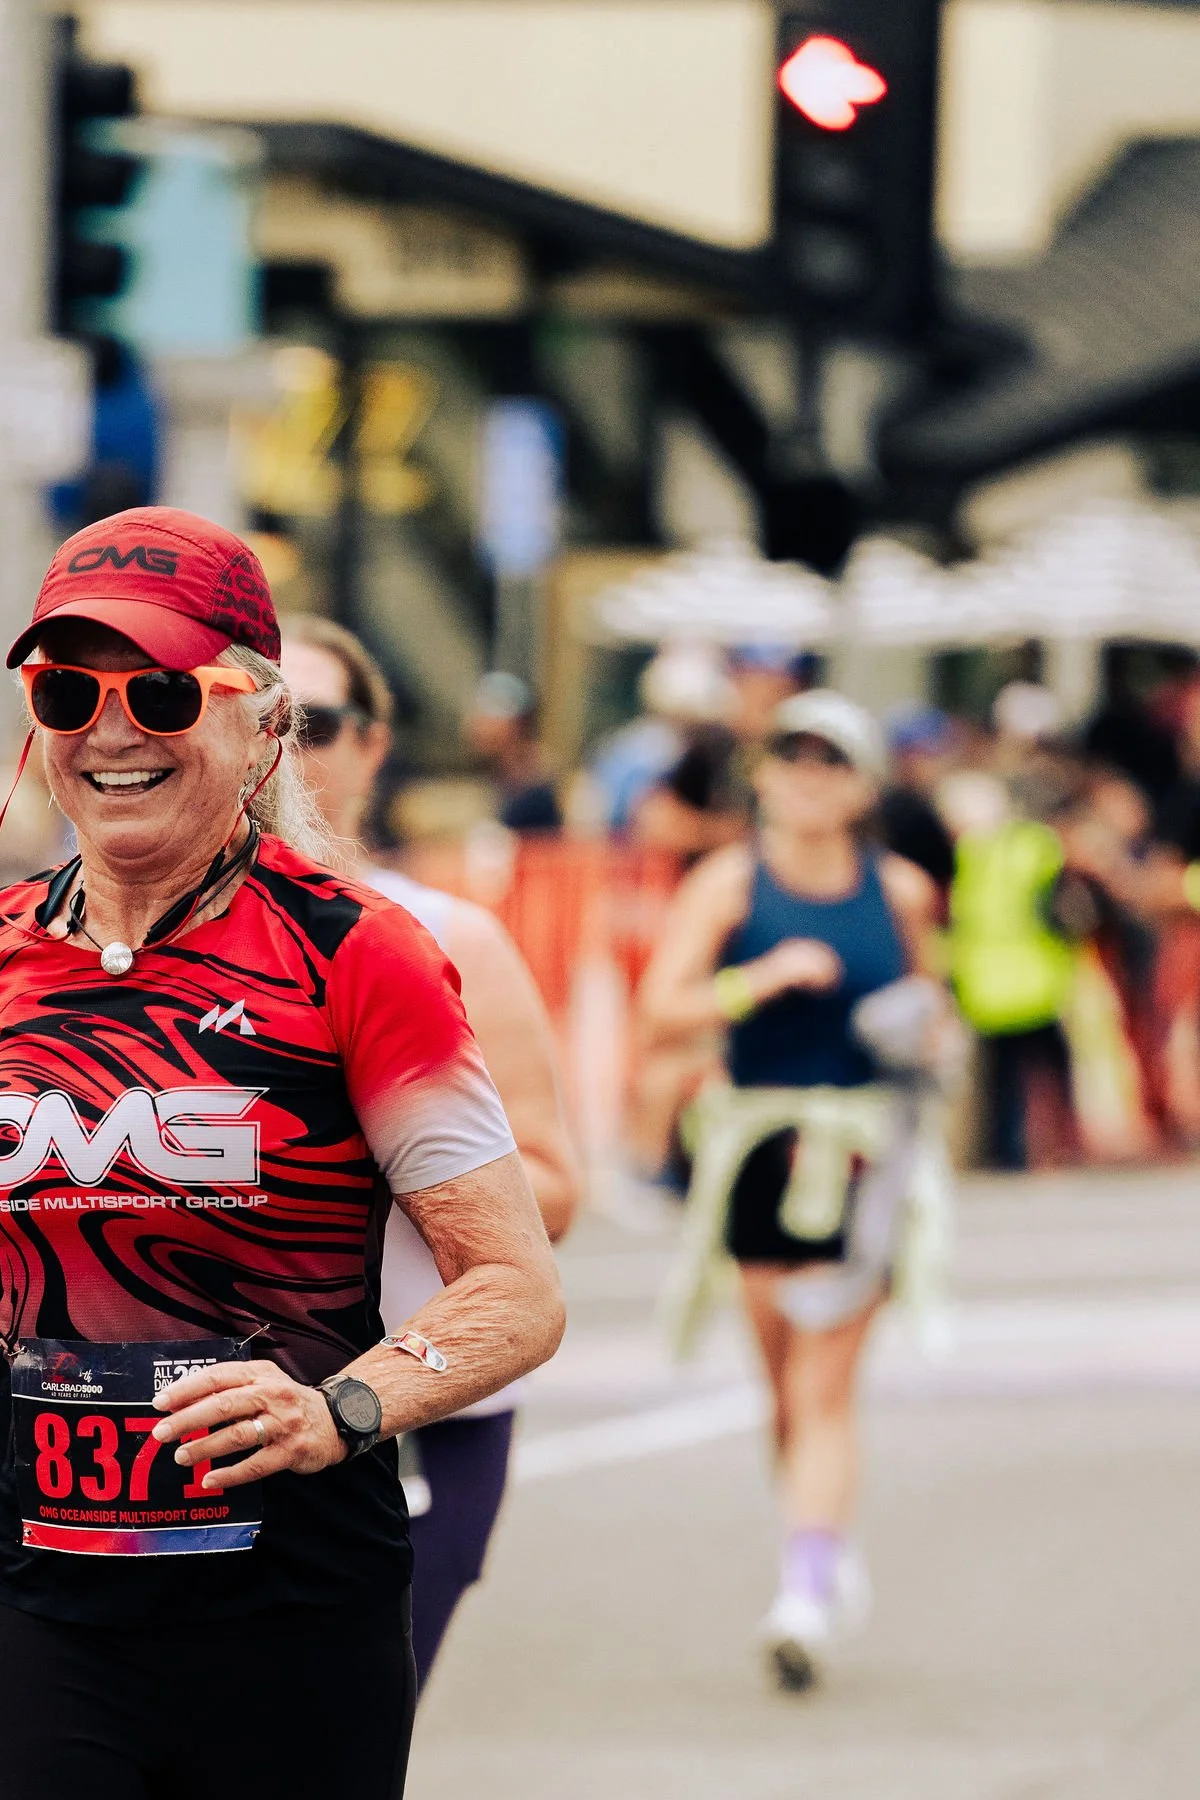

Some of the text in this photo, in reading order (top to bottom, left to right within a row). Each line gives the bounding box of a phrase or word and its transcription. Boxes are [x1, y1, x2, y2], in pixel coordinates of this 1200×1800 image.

[68, 545, 178, 576] OMG
[44, 1195, 181, 1210] MULTISPORT
[185, 1194, 268, 1209] GROUP
[153, 1366, 174, 1379] ALL
[41, 1381, 104, 1394] CARLSBAD5000
[39, 1505, 230, 1523] OMG OCEANSIDE MULTISPORT GROUP
